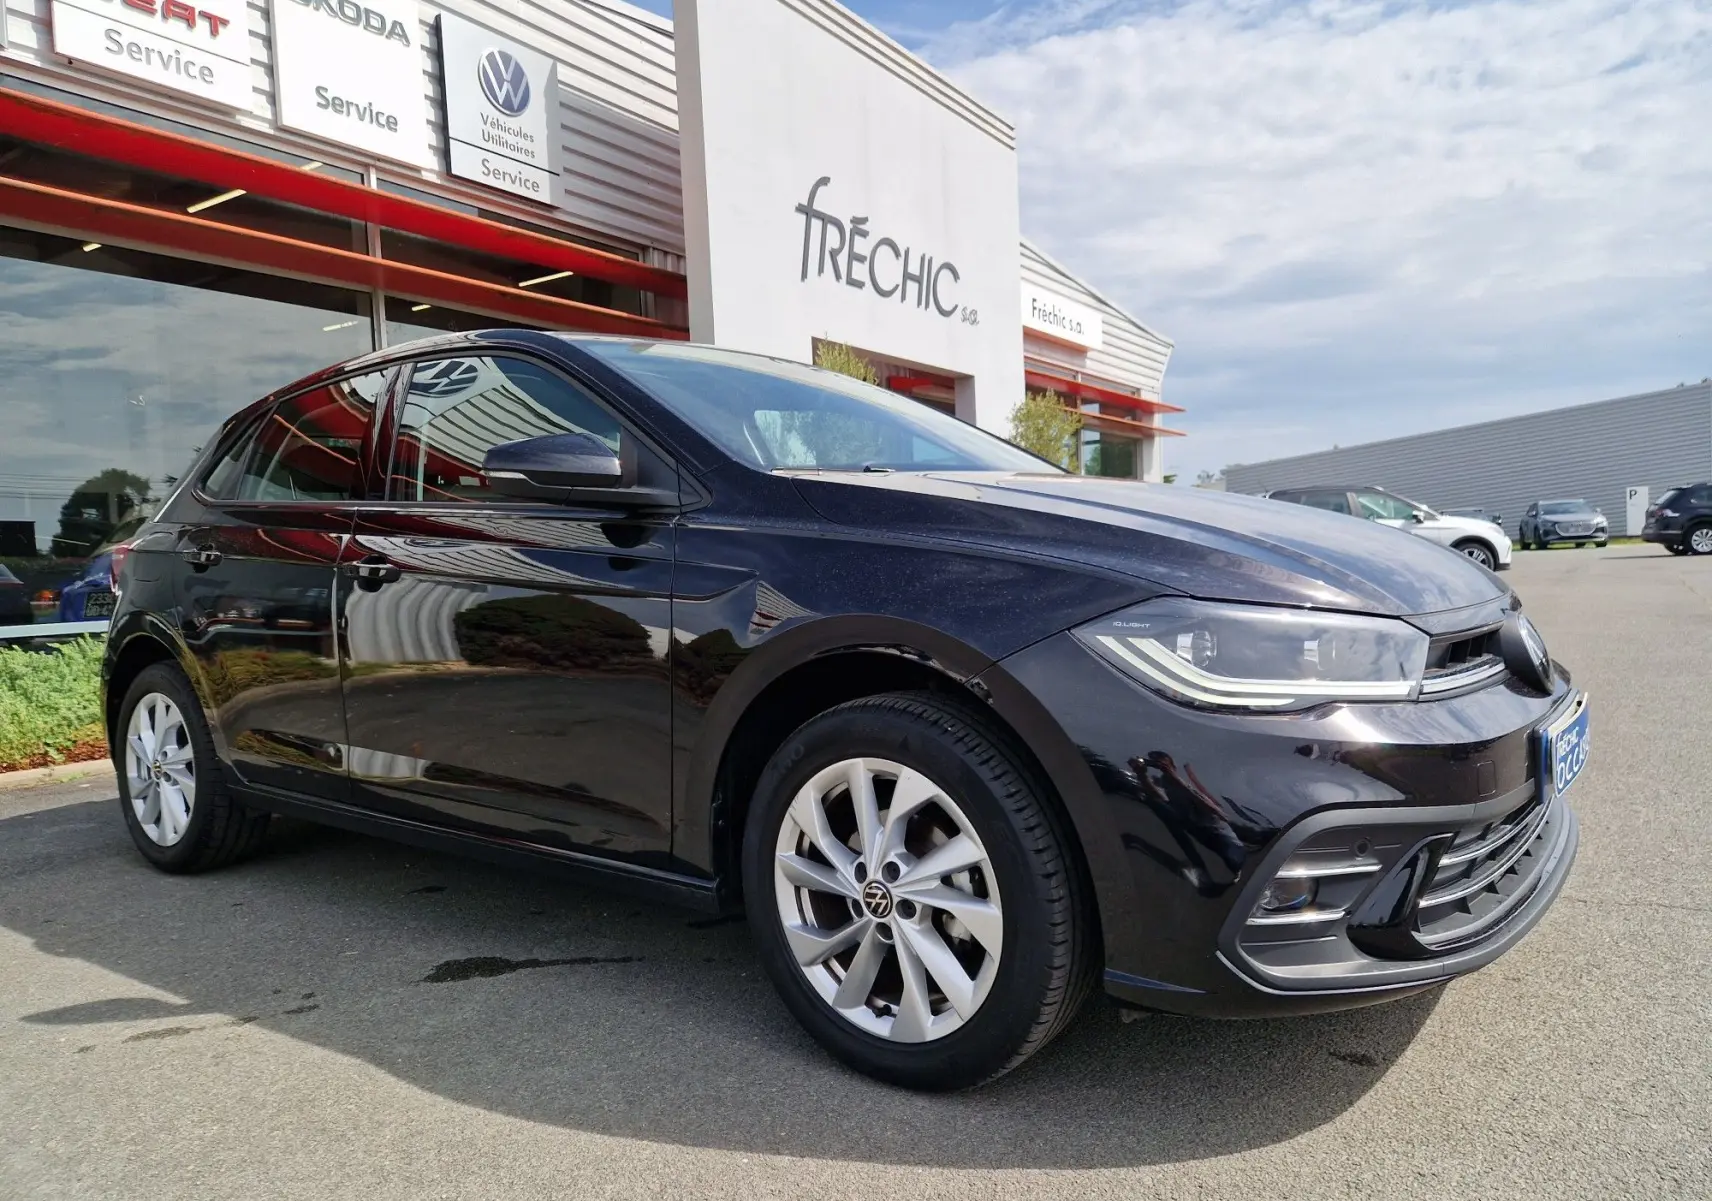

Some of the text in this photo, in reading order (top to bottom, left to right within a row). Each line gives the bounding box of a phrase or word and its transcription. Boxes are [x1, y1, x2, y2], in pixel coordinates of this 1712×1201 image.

[121, 0, 230, 38] EAT
[290, 0, 411, 47] KODA
[104, 28, 215, 85] Service
[315, 85, 398, 132] Service
[480, 112, 535, 143] Véhicules
[482, 129, 536, 158] Utilitaires
[481, 158, 540, 193] Service
[1032, 297, 1067, 329] Fréchic
[1629, 489, 1637, 500] P
